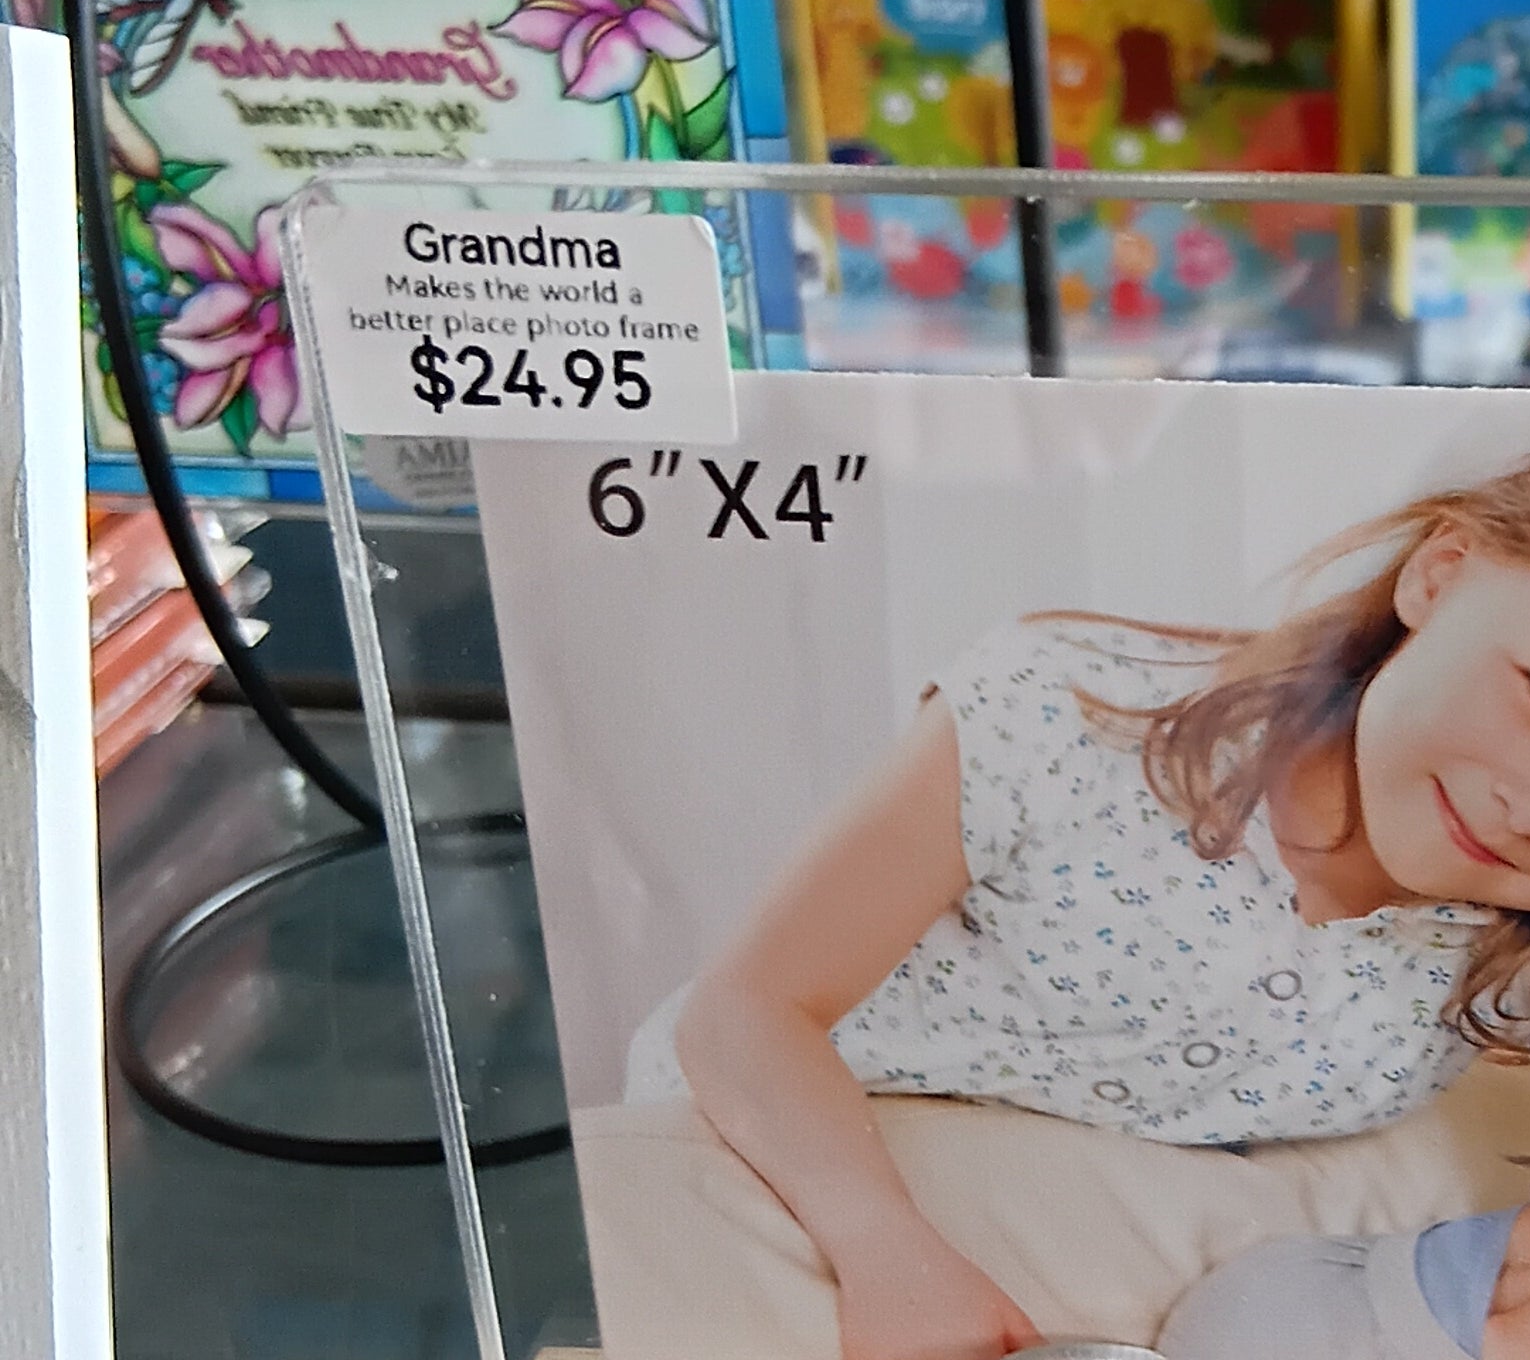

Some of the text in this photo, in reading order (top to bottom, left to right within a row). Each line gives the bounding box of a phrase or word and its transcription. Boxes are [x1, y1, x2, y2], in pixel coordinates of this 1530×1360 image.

[404, 221, 621, 269] Grandma
[386, 274, 643, 305] Makes the world a
[349, 307, 699, 342] better place photo frame
[410, 334, 652, 414] $24.95
